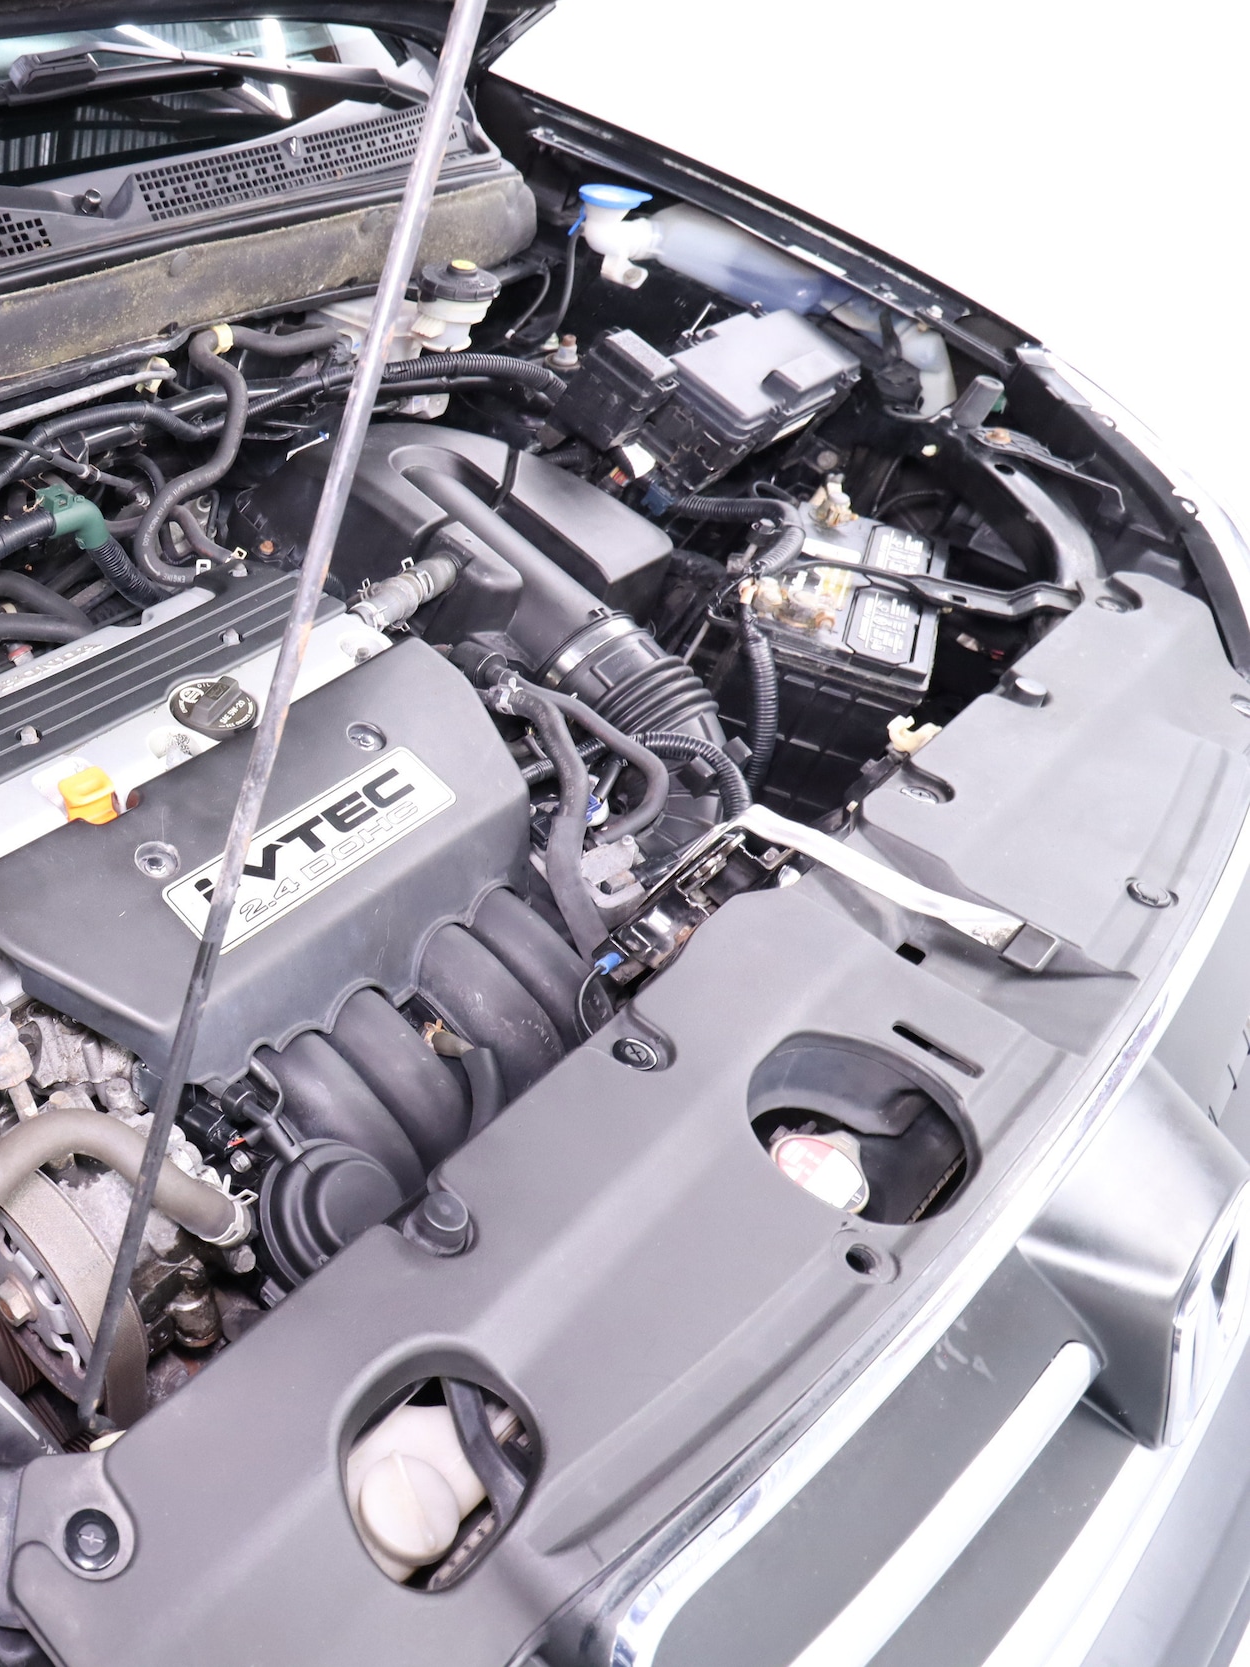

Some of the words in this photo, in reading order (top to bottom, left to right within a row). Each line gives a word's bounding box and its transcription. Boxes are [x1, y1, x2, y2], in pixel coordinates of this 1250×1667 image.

[194, 767, 415, 905] iVTEC
[240, 876, 300, 922] 2.4
[300, 800, 419, 881] DOHC
